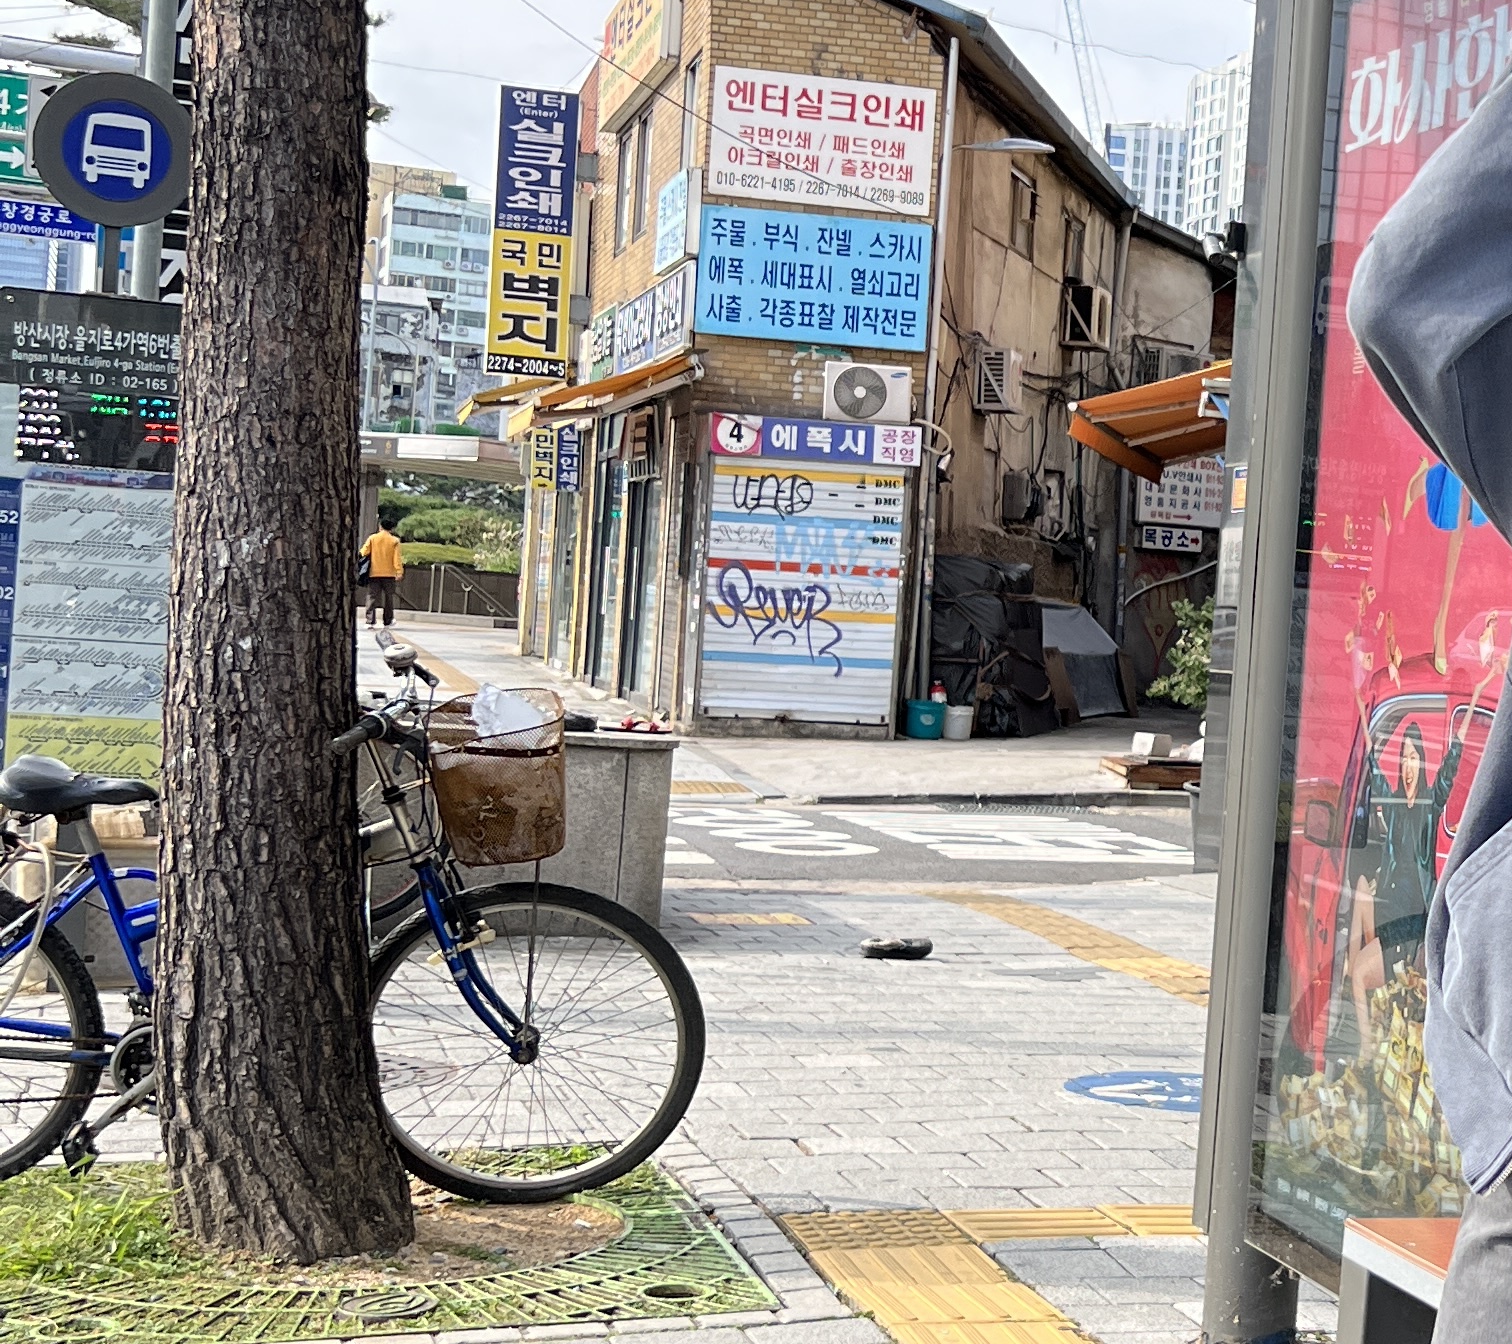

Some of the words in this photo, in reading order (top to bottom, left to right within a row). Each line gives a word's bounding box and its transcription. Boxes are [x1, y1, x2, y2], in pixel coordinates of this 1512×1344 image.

[512, 89, 567, 111] 엔터
[519, 107, 559, 119] (Enter)
[725, 78, 926, 133] 엔터실크인쇄
[738, 124, 812, 151] 곡면인쇄
[833, 134, 906, 160] 패드인쇄
[505, 118, 567, 217] 실크인쇄
[727, 145, 820, 175] 아크릴인쇄
[840, 157, 914, 184] 출장인쇄
[716, 169, 796, 194] 010-6221-4195
[805, 179, 860, 199] 2267-7014
[870, 186, 925, 206] 2269-9089
[1, 202, 73, 225] 창경궁로
[498, 212, 568, 227] 2267-7014
[501, 238, 562, 270] 국민
[868, 231, 923, 264] 스카시
[850, 266, 921, 301] 열쇠고리
[497, 271, 560, 354] 벽지
[759, 297, 835, 332] 각종표찰
[841, 304, 917, 339] 제작전문
[41, 369, 83, 385] 정류소
[89, 372, 105, 385] ID
[122, 376, 168, 391] 02-165
[135, 360, 166, 372] Station
[487, 355, 566, 378] 2274-2004~5
[729, 420, 744, 444] 4
[771, 423, 867, 456] 에폭시
[881, 428, 917, 445] 공장
[534, 425, 554, 482] 민벽지
[881, 446, 915, 463] 직영
[1145, 528, 1190, 549] 목공소
